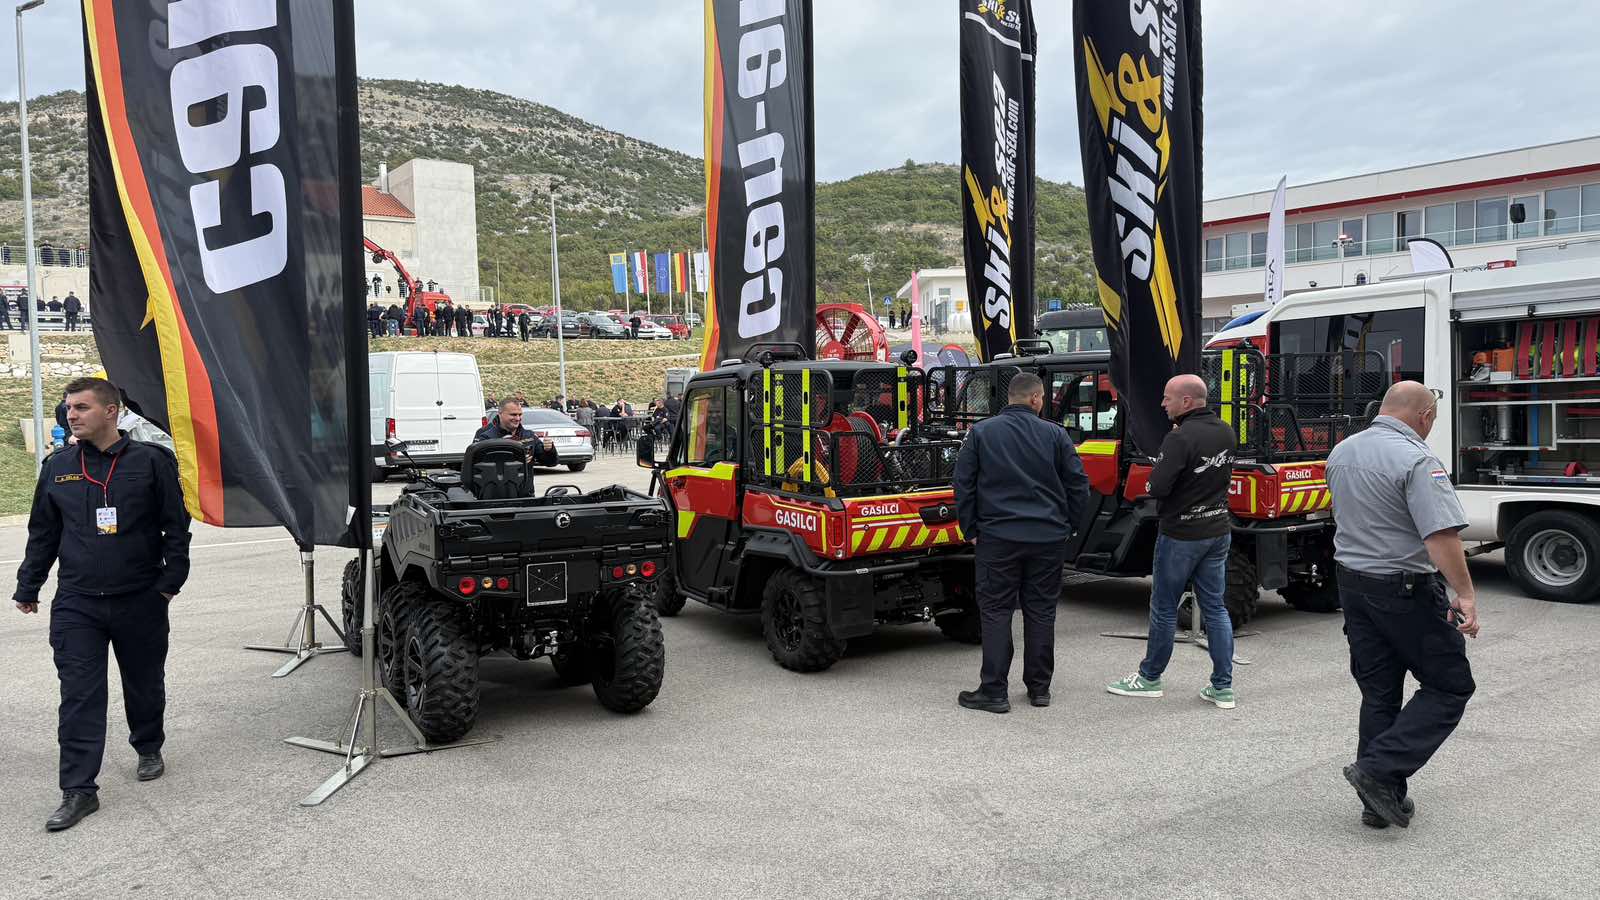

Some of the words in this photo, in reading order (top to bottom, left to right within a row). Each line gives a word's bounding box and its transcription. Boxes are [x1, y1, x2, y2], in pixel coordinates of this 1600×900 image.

[1118, 52, 1161, 134] &
[1285, 470, 1312, 480] GASILCI
[861, 504, 899, 517] GASILCI
[775, 509, 816, 532] GASILCI
